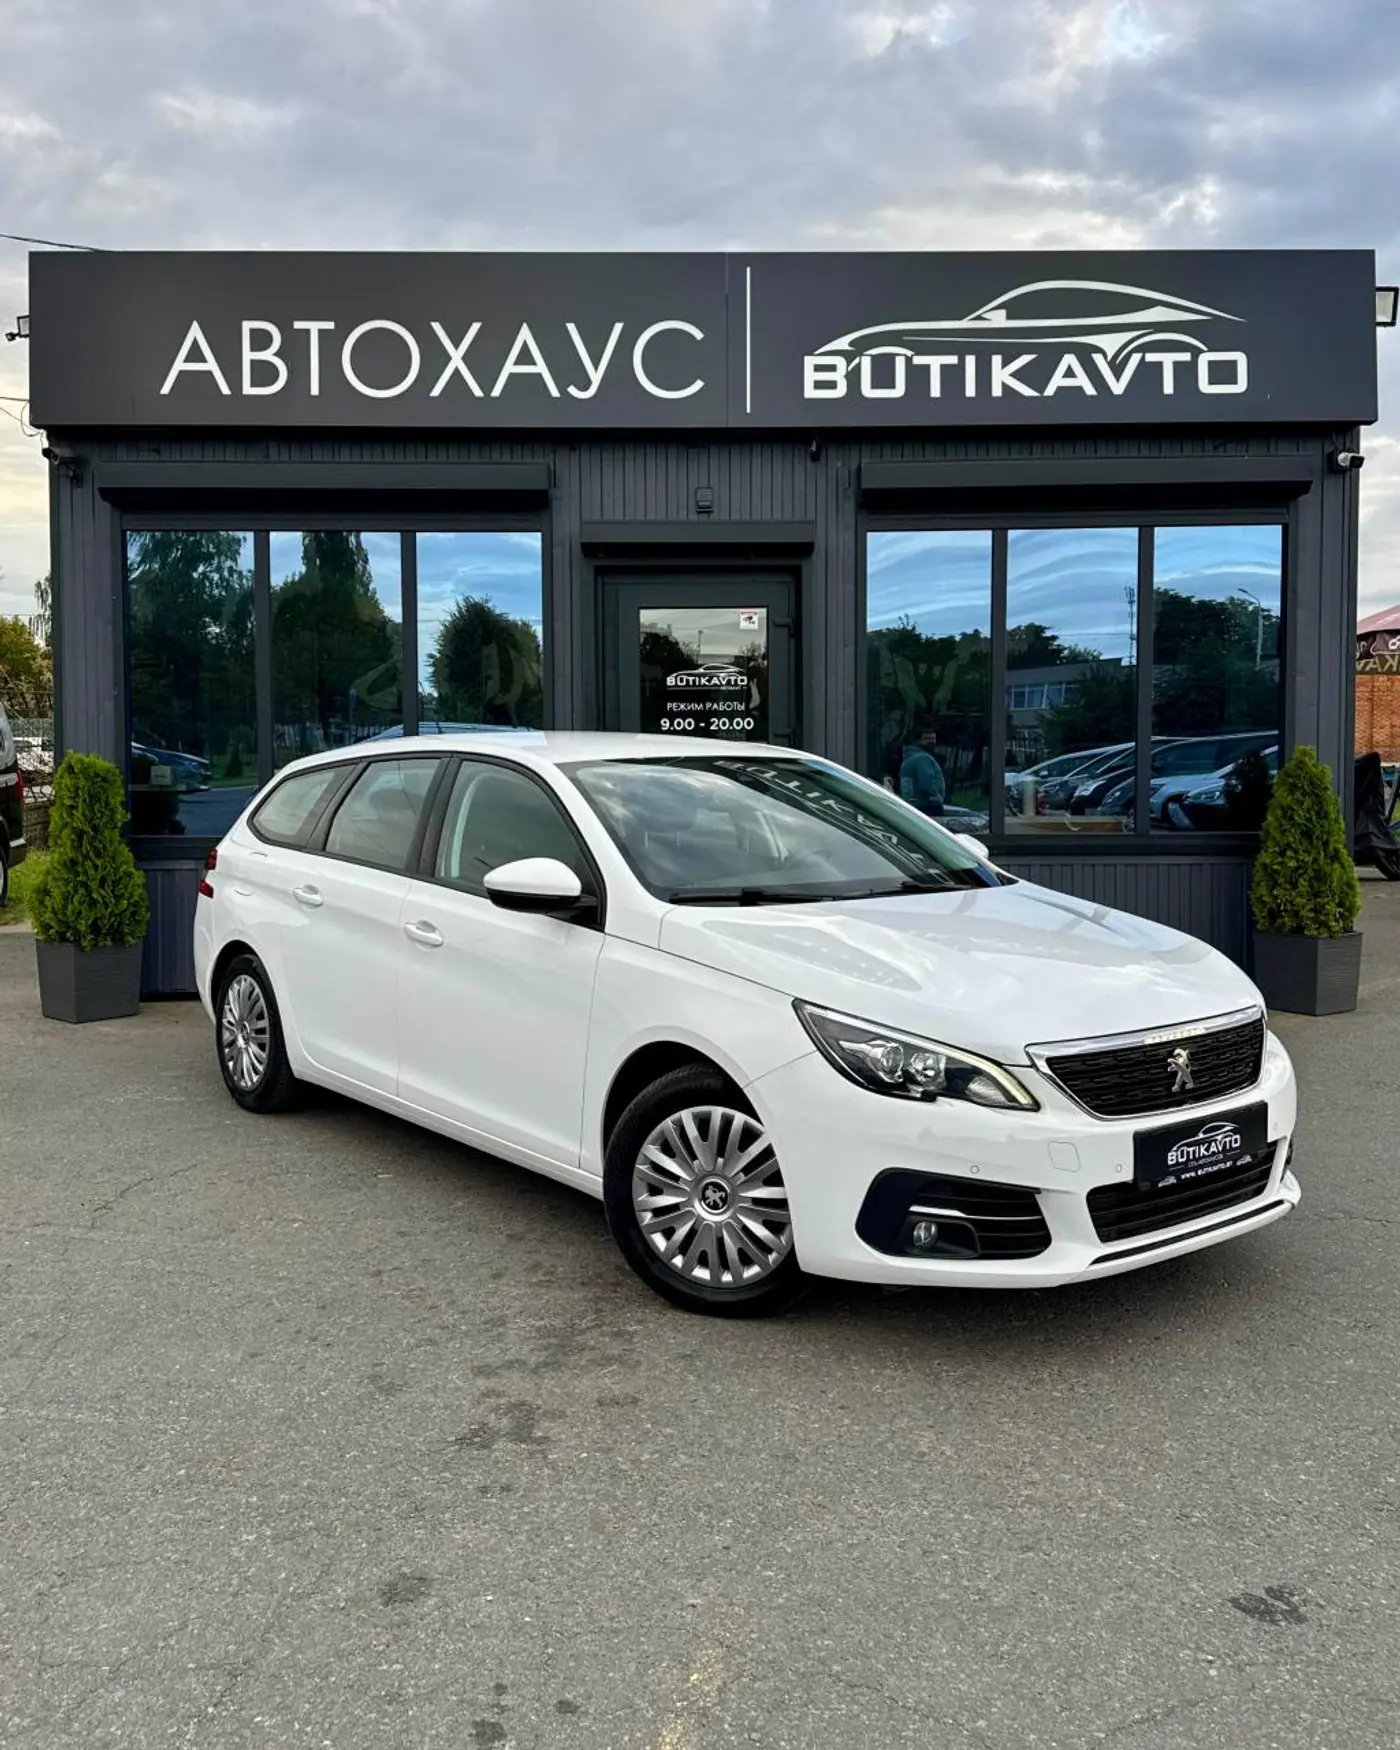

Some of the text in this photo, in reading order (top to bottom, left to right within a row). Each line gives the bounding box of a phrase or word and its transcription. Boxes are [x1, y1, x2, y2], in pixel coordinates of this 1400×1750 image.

[160, 320, 704, 399] АВТОХАУС
[803, 351, 1248, 399] BUTIKAVTO
[666, 674, 748, 686] BUTIKAVTO
[667, 702, 745, 711] РЕЖИМ РАБОТЫ
[660, 717, 695, 730] 9.00
[709, 717, 754, 730] 20.00
[1167, 1134, 1241, 1166] BUTIKAVTO
